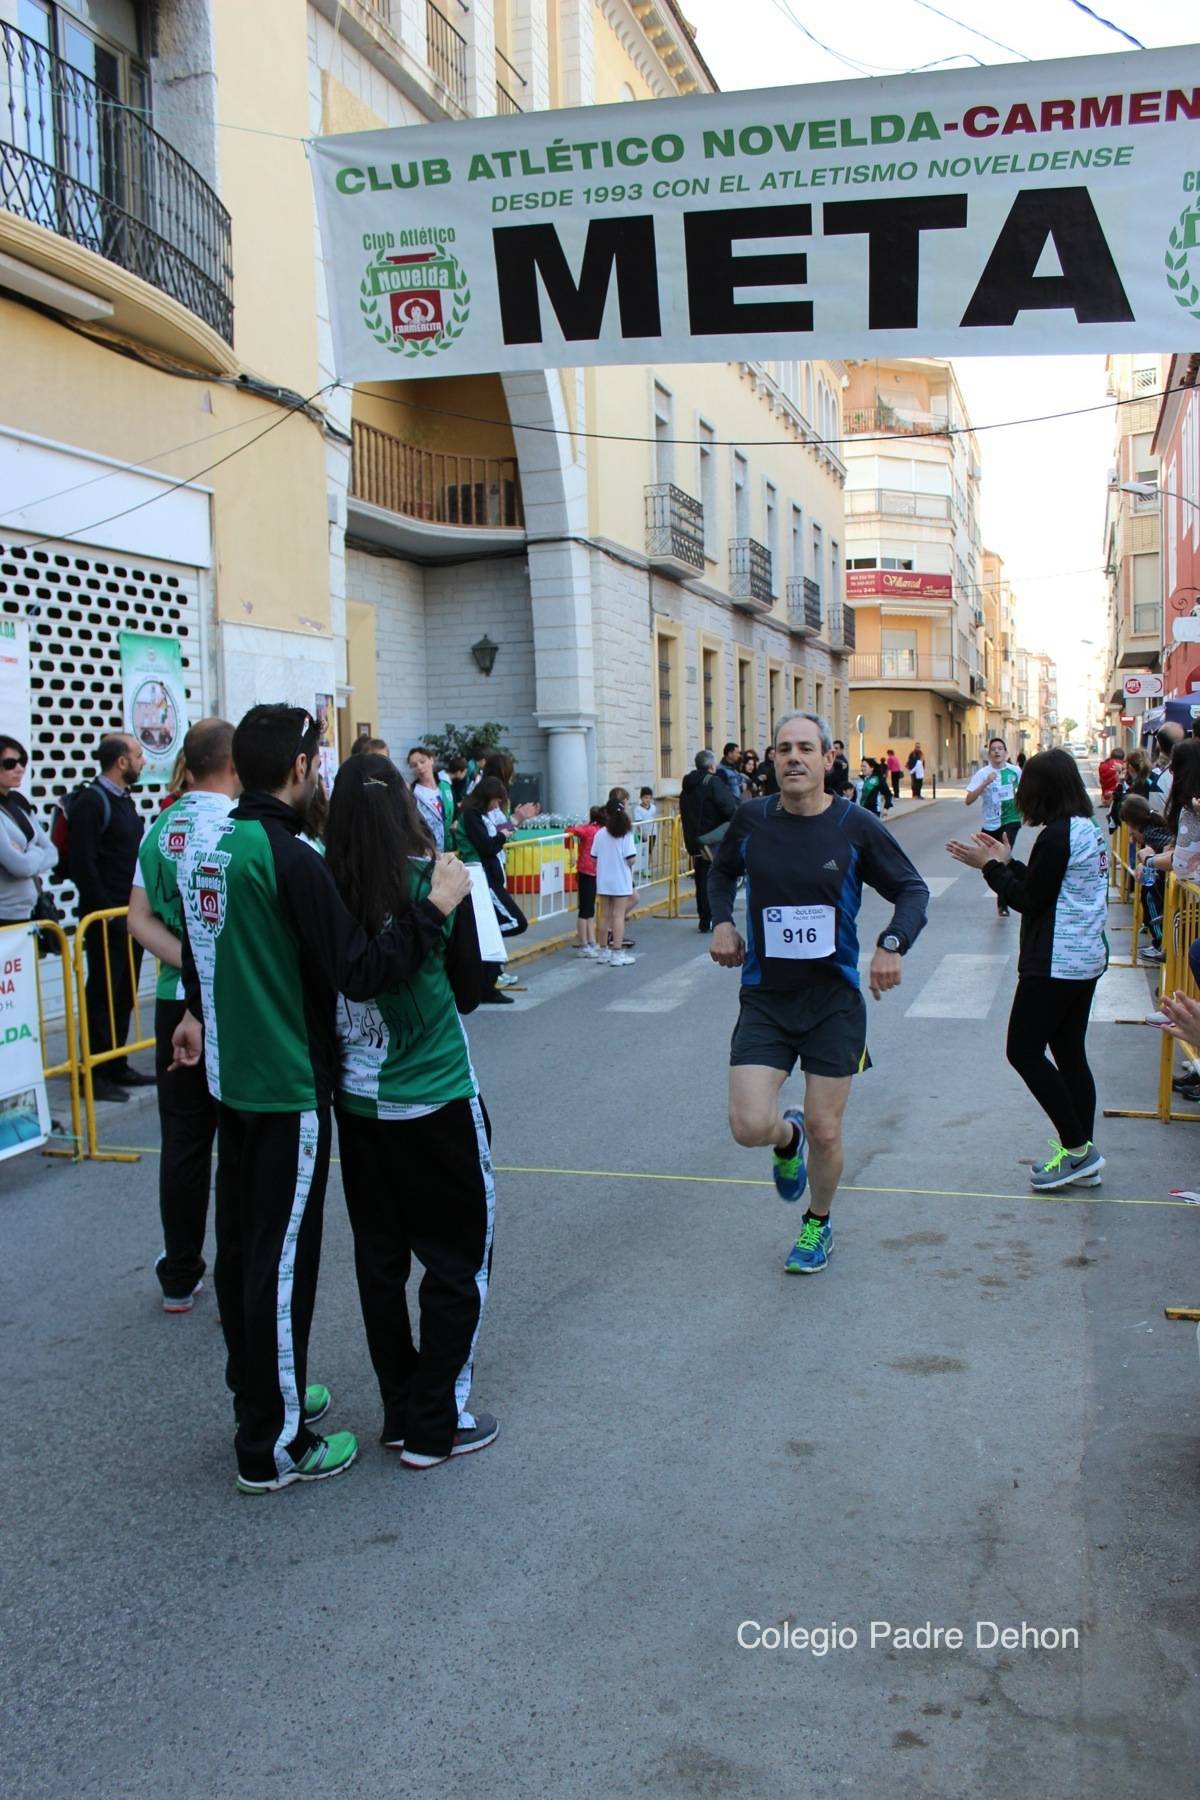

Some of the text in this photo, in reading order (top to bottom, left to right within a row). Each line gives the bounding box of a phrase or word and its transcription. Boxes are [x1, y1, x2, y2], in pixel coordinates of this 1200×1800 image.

[336, 158, 452, 195] CLUB
[468, 134, 685, 182] ATLÉTICO
[492, 146, 1135, 213] DESDE 1993 CON EL ATLETISMO NOVELDENSE
[362, 226, 456, 251] Club Atlético
[492, 185, 1137, 346] META
[377, 266, 449, 293] Novelda
[783, 928, 817, 944] 916
[4, 958, 22, 975] DE
